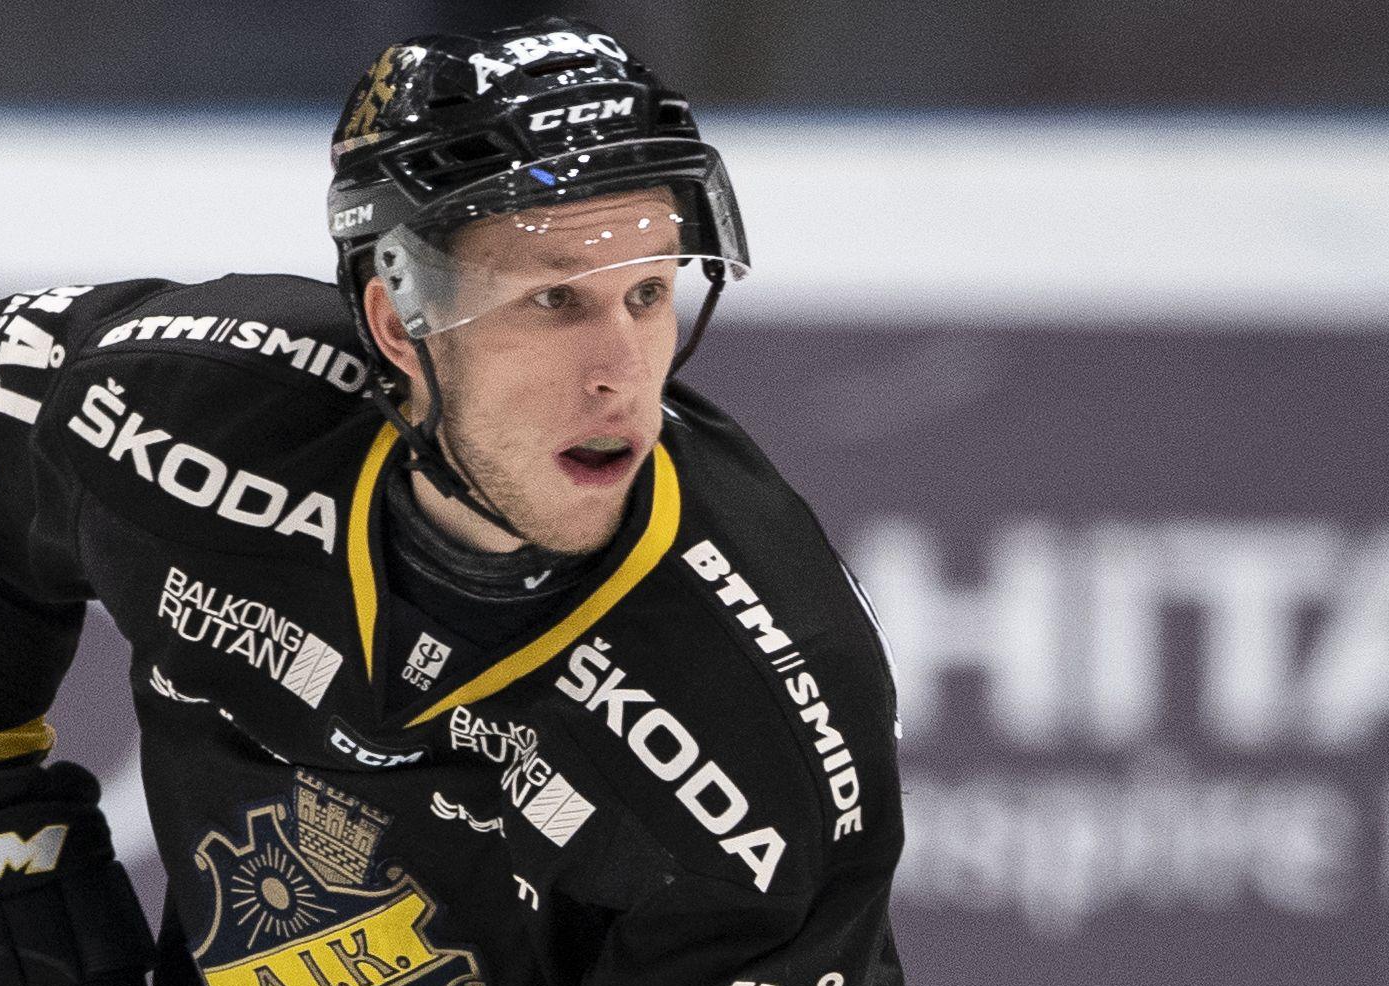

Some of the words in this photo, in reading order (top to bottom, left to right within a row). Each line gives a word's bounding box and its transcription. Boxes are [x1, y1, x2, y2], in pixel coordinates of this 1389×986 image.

[529, 97, 634, 131] CCM
[333, 204, 373, 231] CCM
[68, 377, 336, 554] ŠKODA
[158, 590, 289, 680] RUTAN
[163, 566, 304, 652] BALKONG
[330, 728, 423, 767] CCM
[555, 636, 786, 893] ŠKODA
